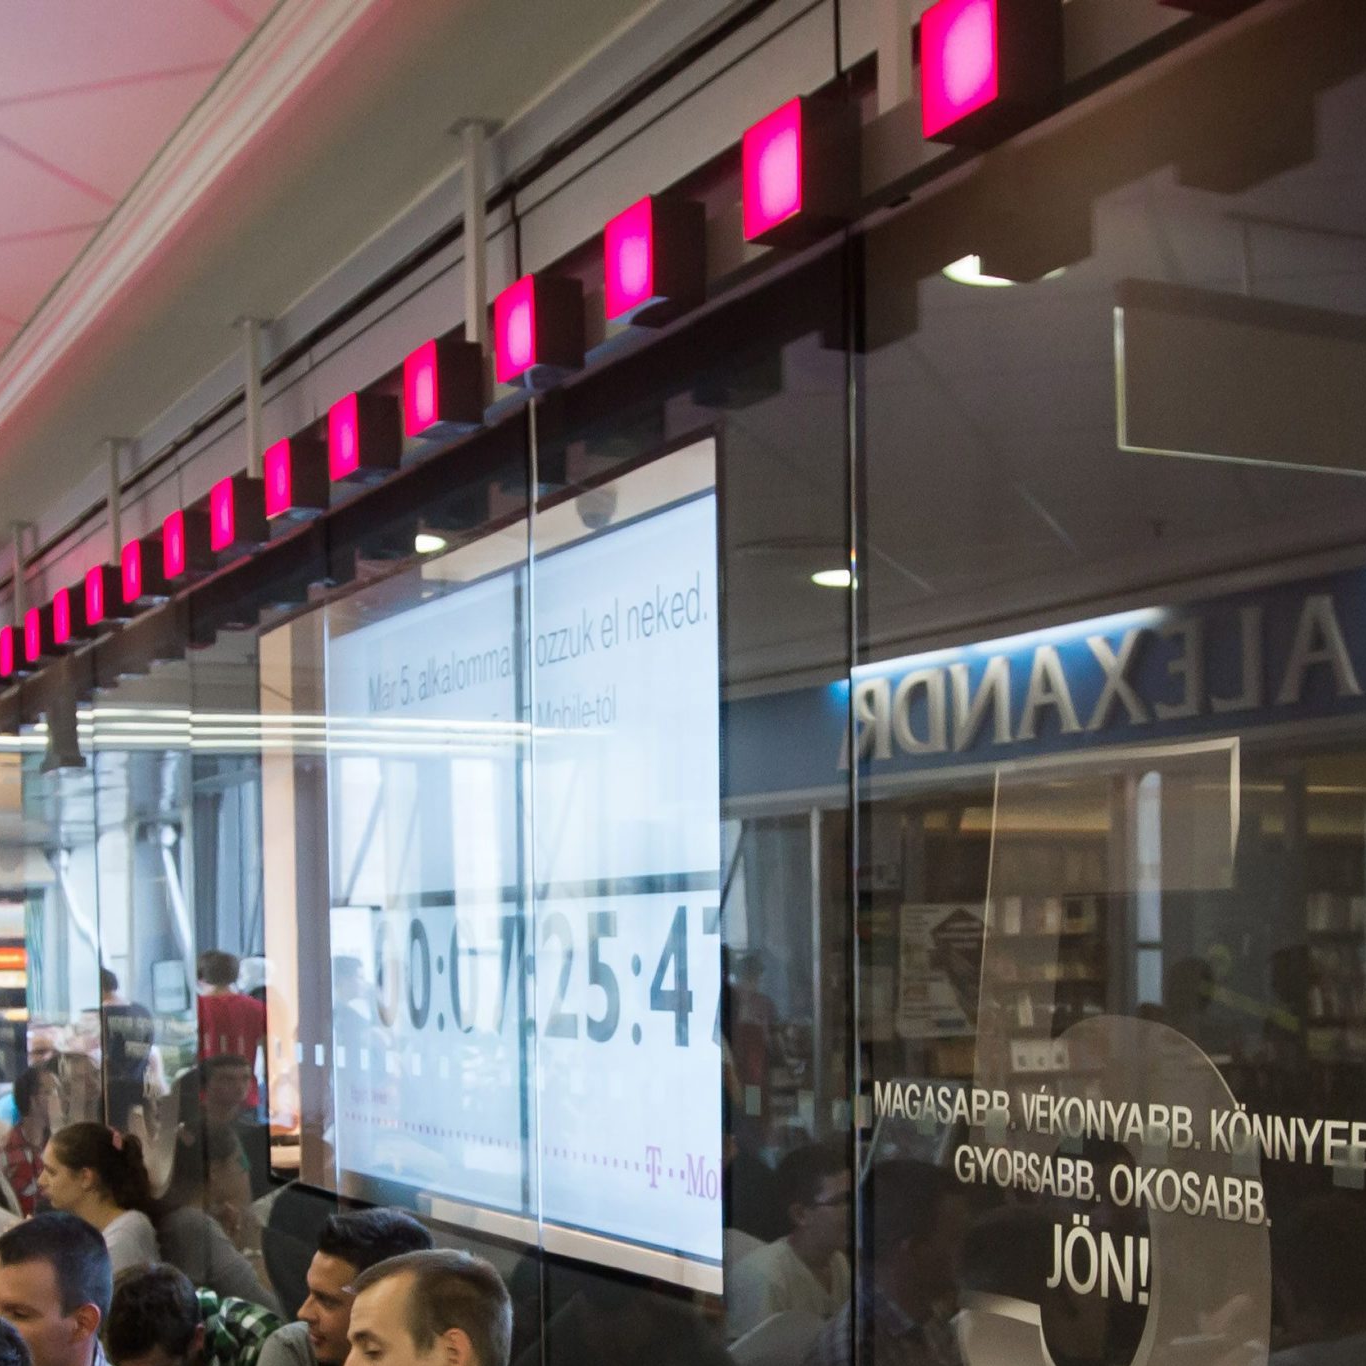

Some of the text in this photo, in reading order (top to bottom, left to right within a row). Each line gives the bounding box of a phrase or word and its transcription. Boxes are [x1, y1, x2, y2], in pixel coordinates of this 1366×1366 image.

[368, 673, 398, 713] Már
[400, 663, 415, 706] 5.
[418, 633, 519, 702] alkalomma
[600, 597, 620, 650] el
[626, 570, 709, 640] neked.
[873, 1079, 1017, 1131] MAGASABB.
[1021, 1082, 1202, 1153] VÉKONYABB.
[953, 1143, 1273, 1228] GYORSABB. OKOSABB.
[1045, 1214, 1150, 1306] JÖN!
